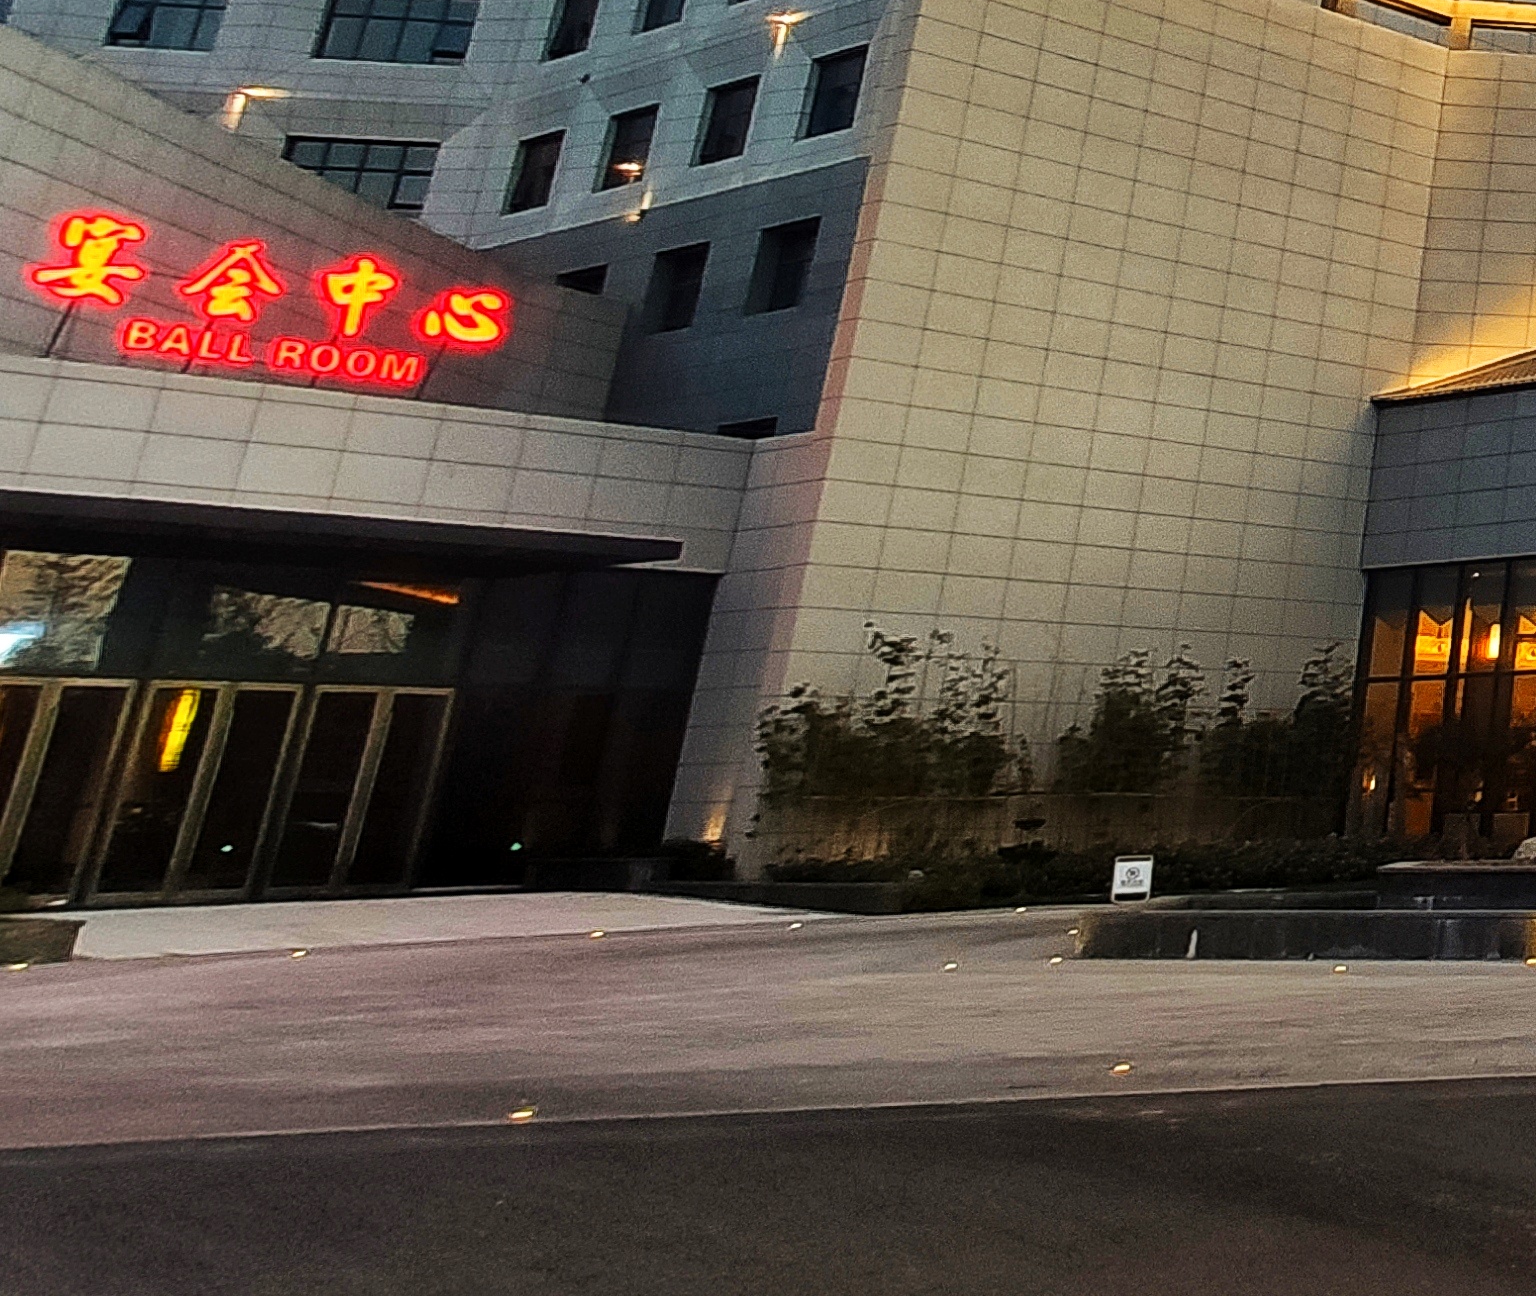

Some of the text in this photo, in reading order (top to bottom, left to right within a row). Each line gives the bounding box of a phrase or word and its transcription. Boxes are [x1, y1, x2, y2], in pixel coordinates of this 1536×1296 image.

[33, 217, 502, 342] 宴会中心
[125, 321, 419, 383] BALL ROOM
